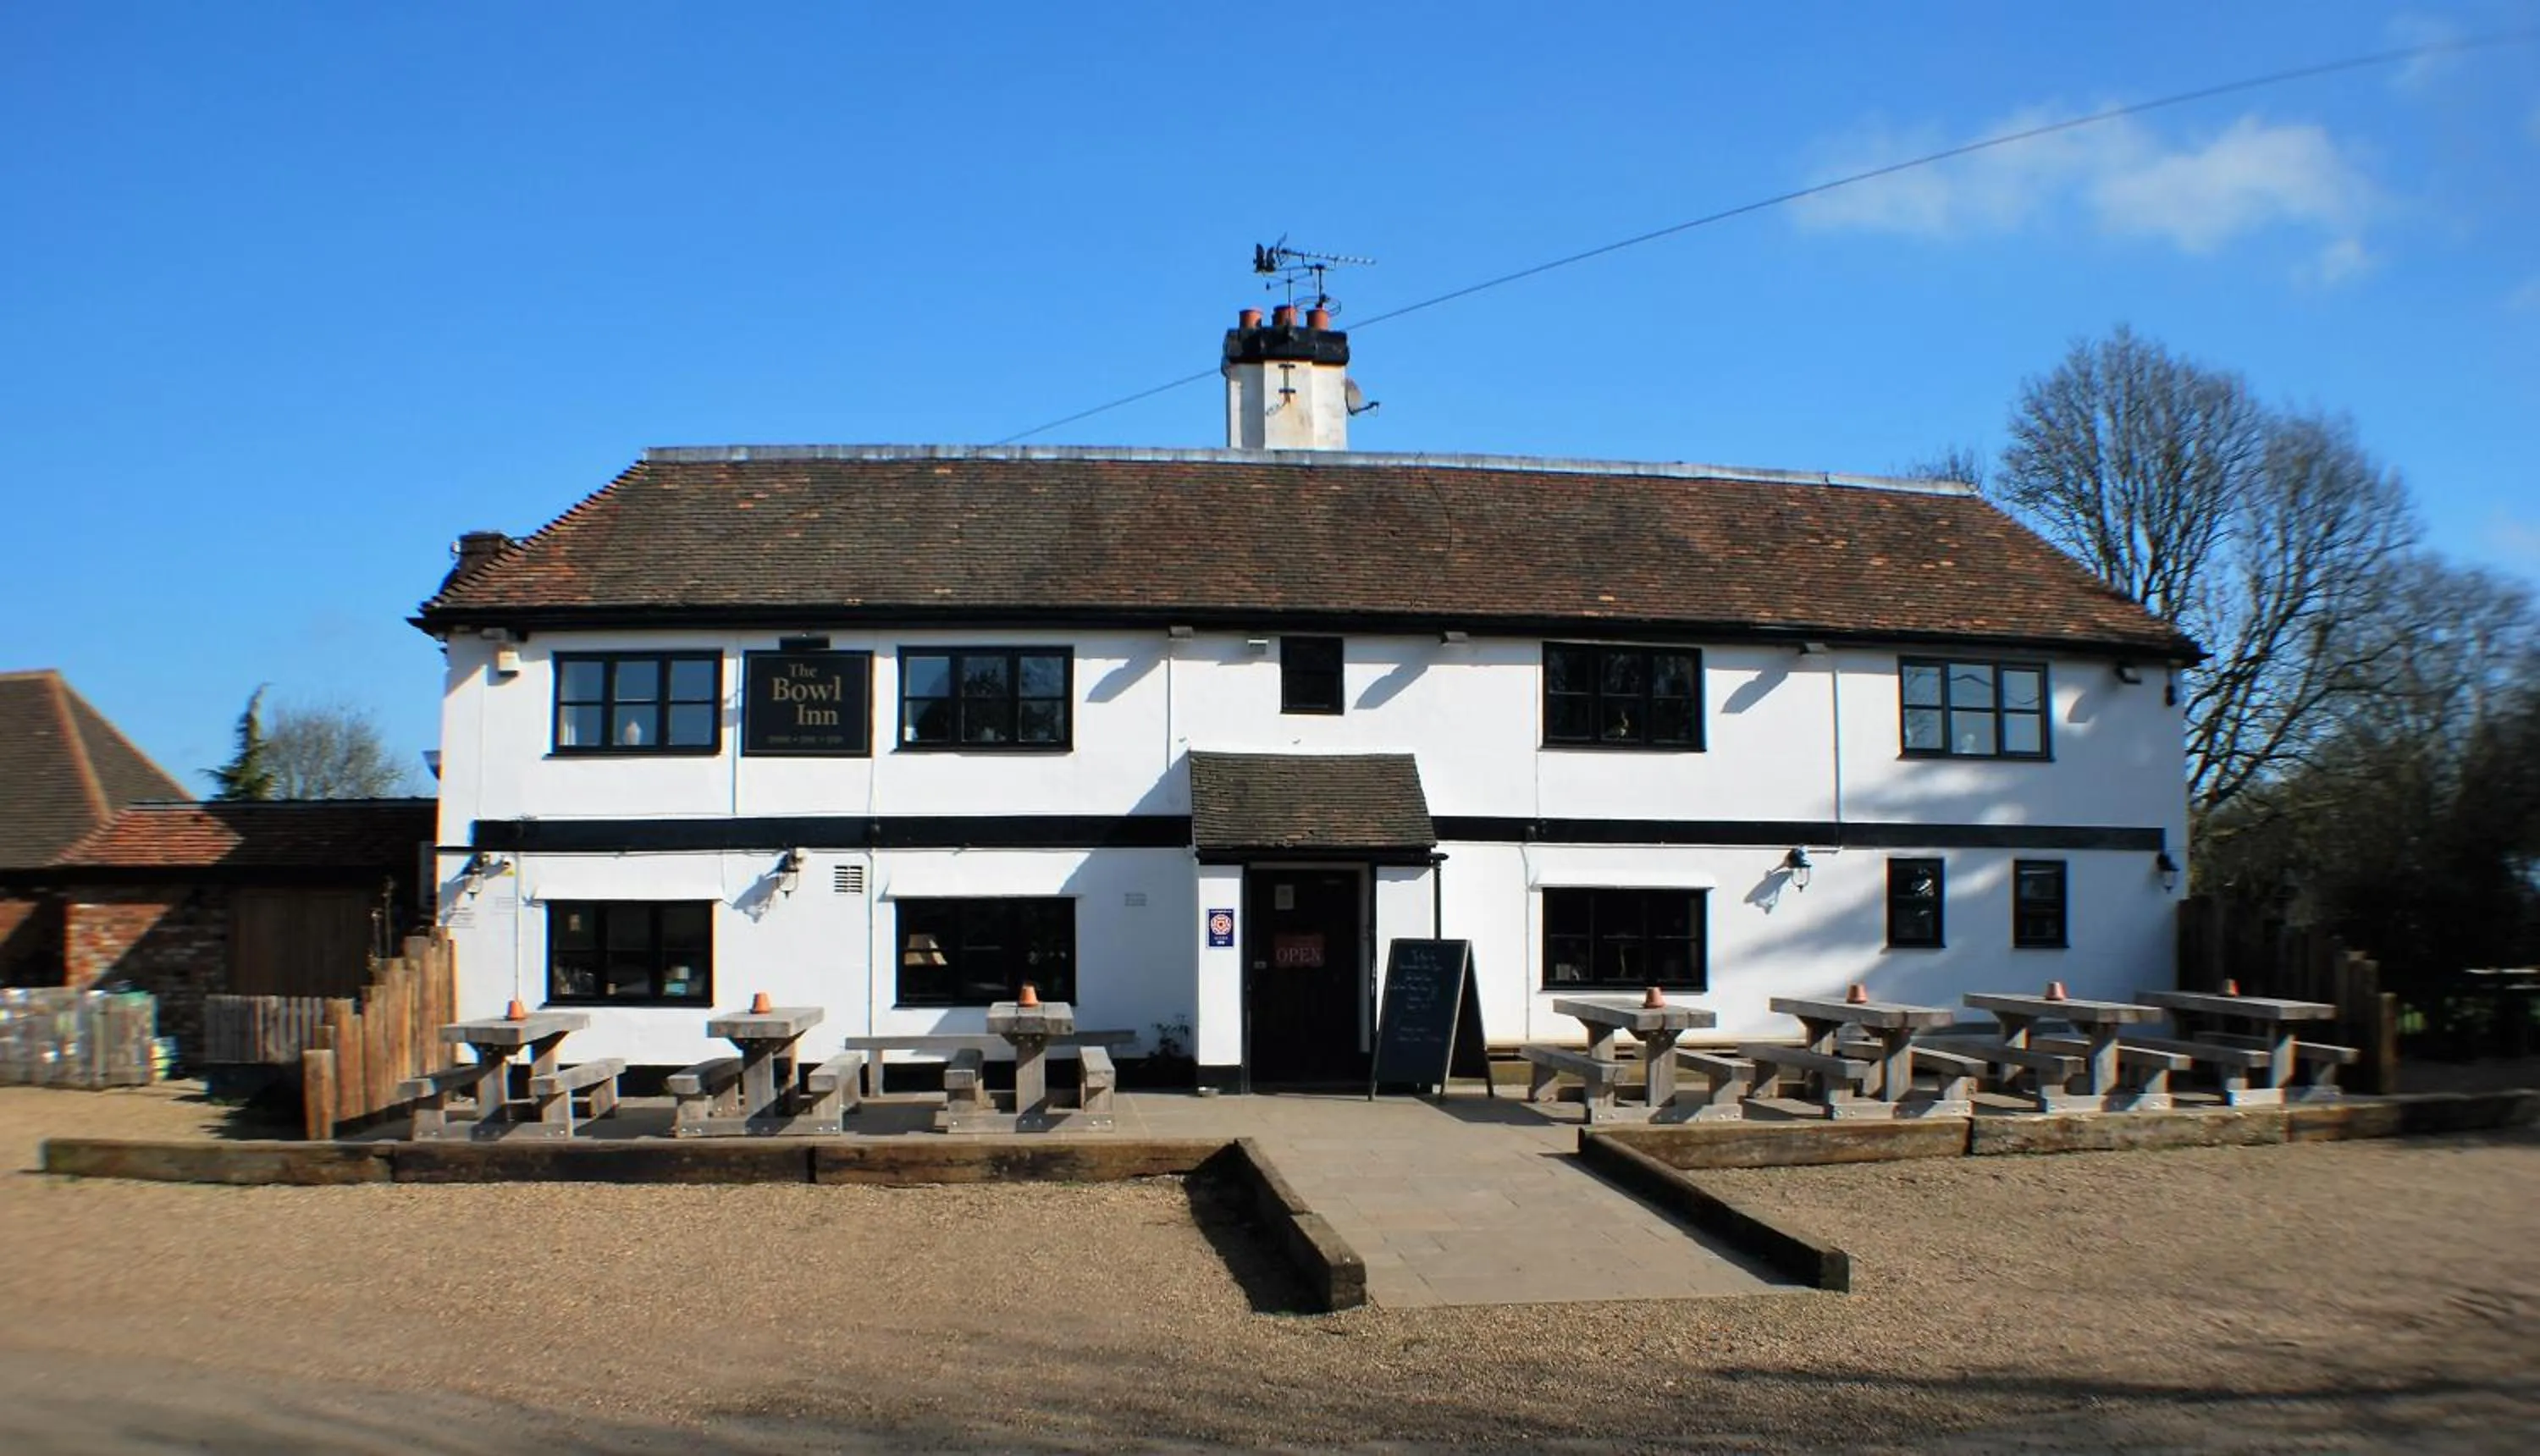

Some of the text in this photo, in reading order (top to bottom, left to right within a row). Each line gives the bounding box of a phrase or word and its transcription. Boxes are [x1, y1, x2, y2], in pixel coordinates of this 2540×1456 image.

[788, 663, 818, 677] The
[771, 675, 842, 703] Bowl
[795, 704, 840, 725] Inn
[1276, 946, 1322, 963] OPEN
